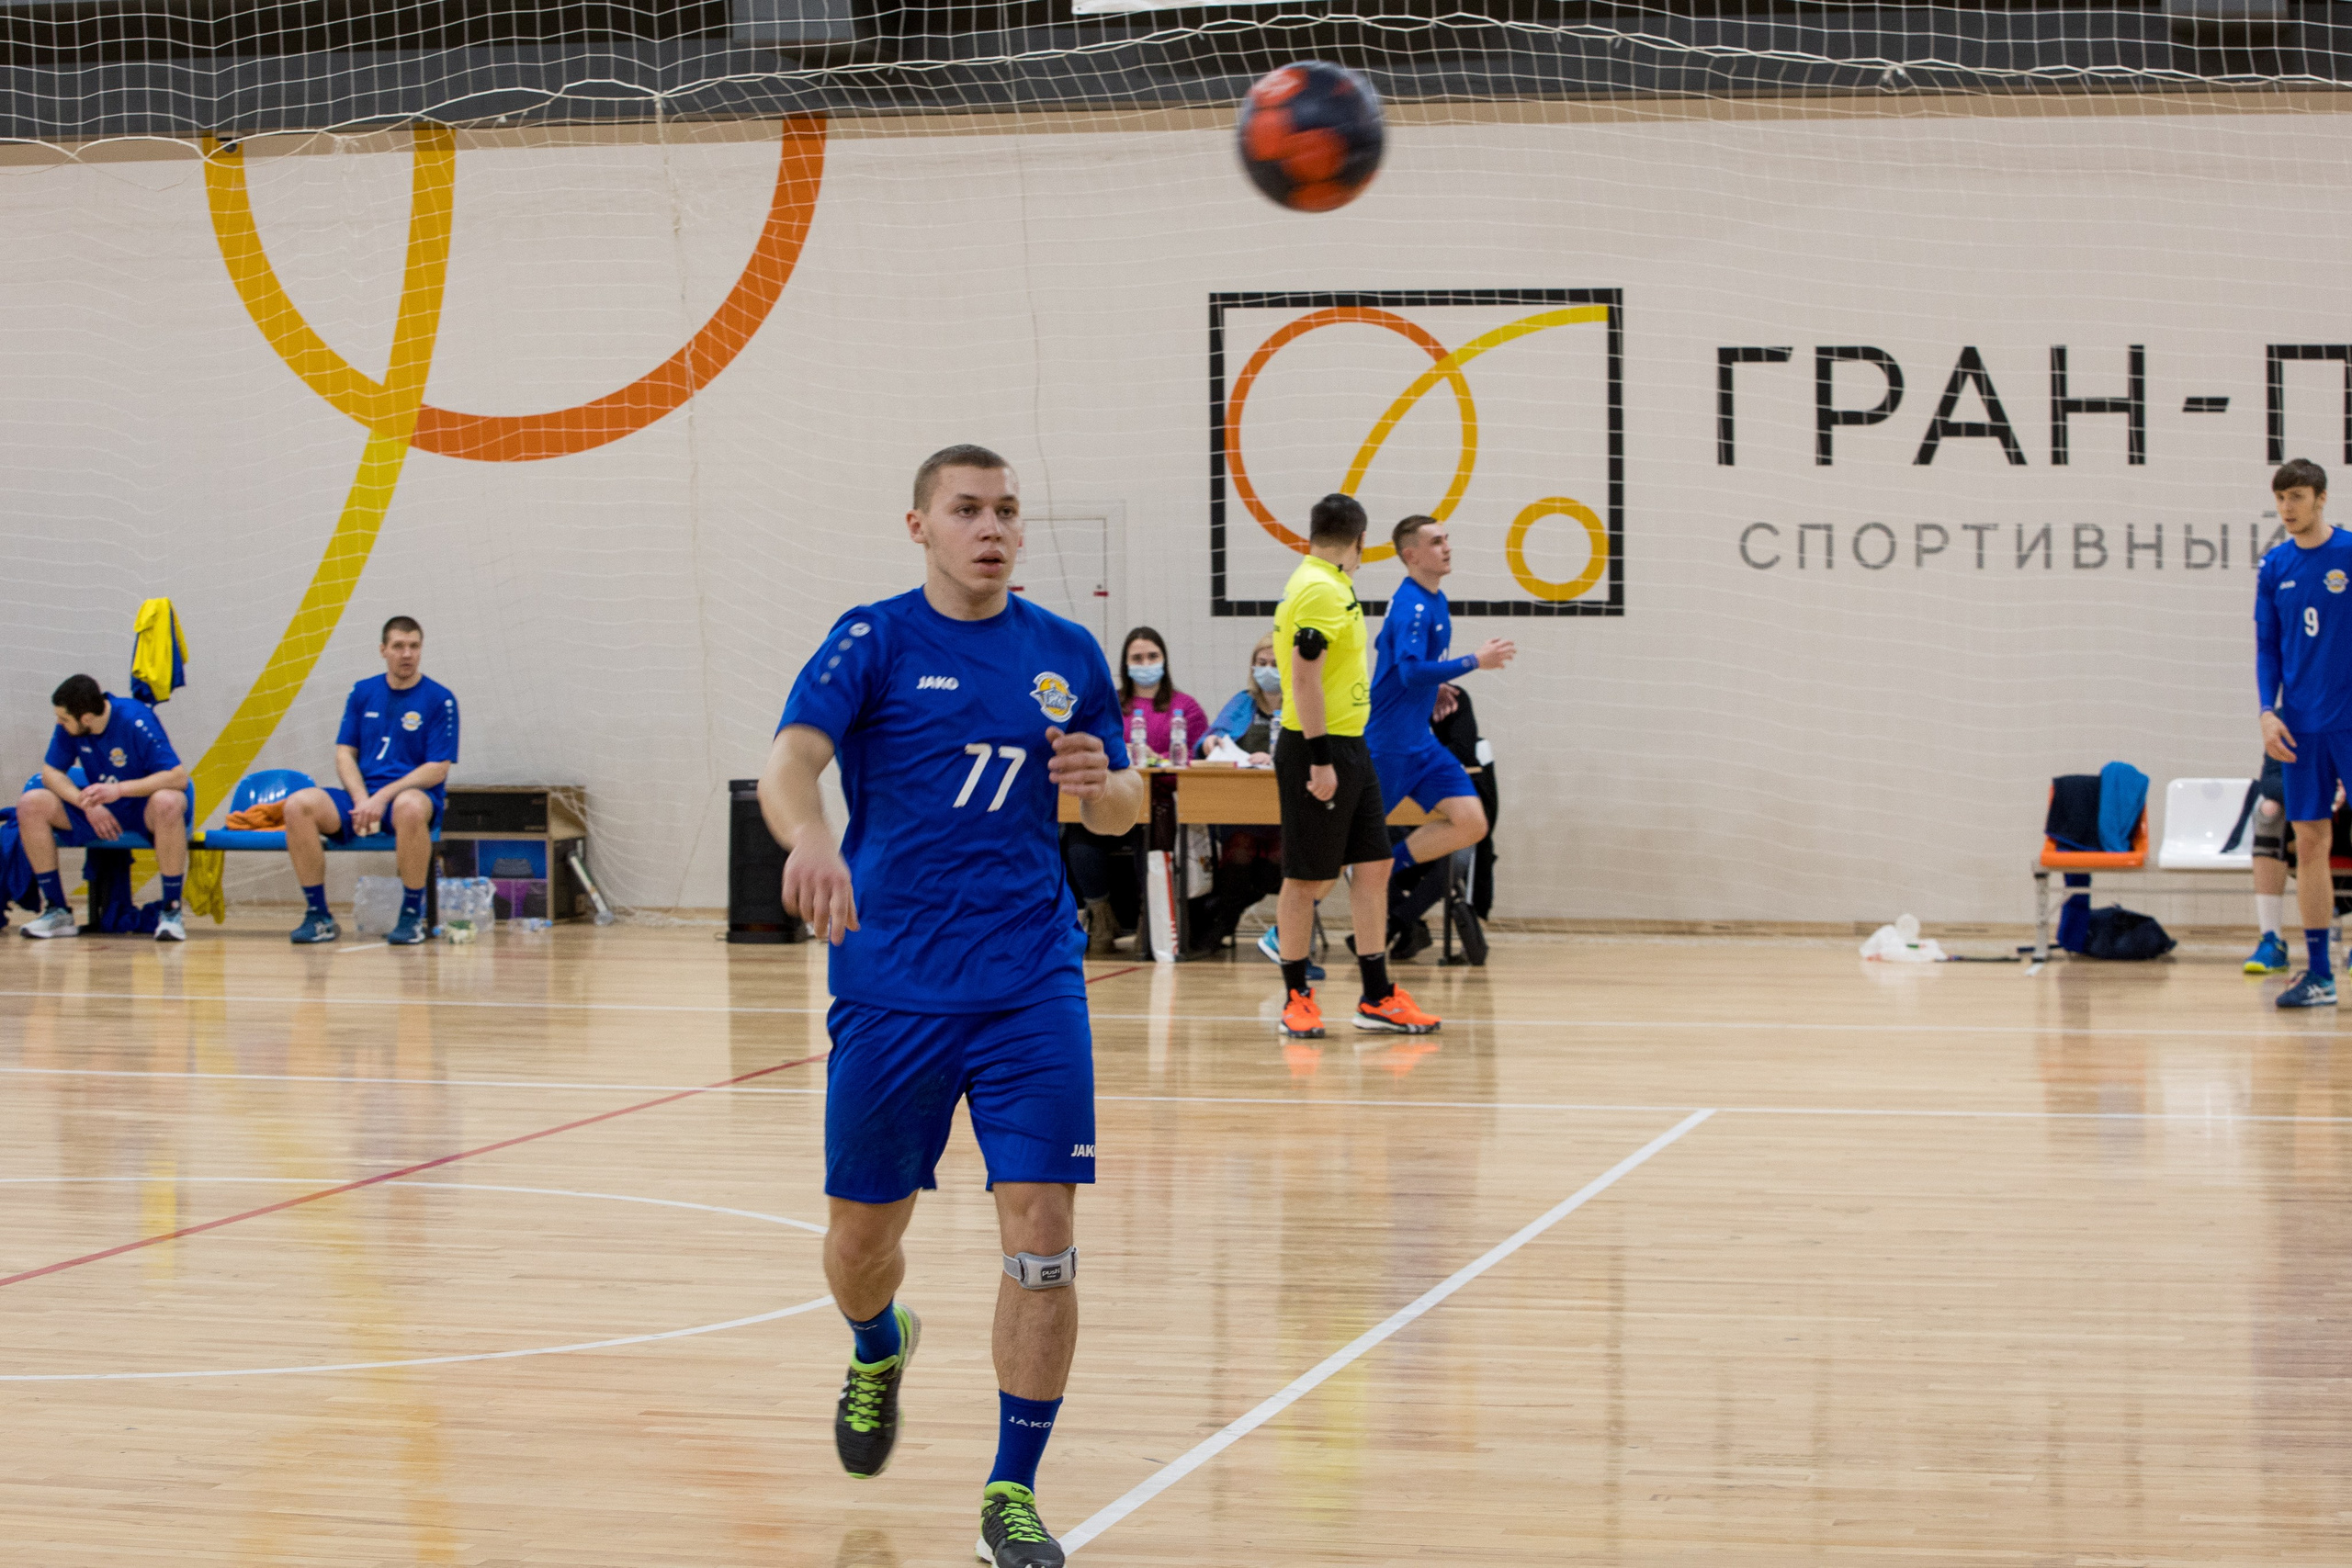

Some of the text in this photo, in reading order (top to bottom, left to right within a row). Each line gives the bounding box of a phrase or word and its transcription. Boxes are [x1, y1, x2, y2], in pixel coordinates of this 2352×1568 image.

[1716, 344, 2352, 467] ГРАН-П
[1739, 512, 2285, 570] СПОРТИВНЫЙ
[2304, 606, 2319, 637] 9
[916, 675, 959, 691] JAKO
[376, 737, 390, 761] 7
[953, 743, 1027, 812] 77
[1071, 1144, 1096, 1157] JAK
[1009, 1416, 1052, 1427] JAKO
